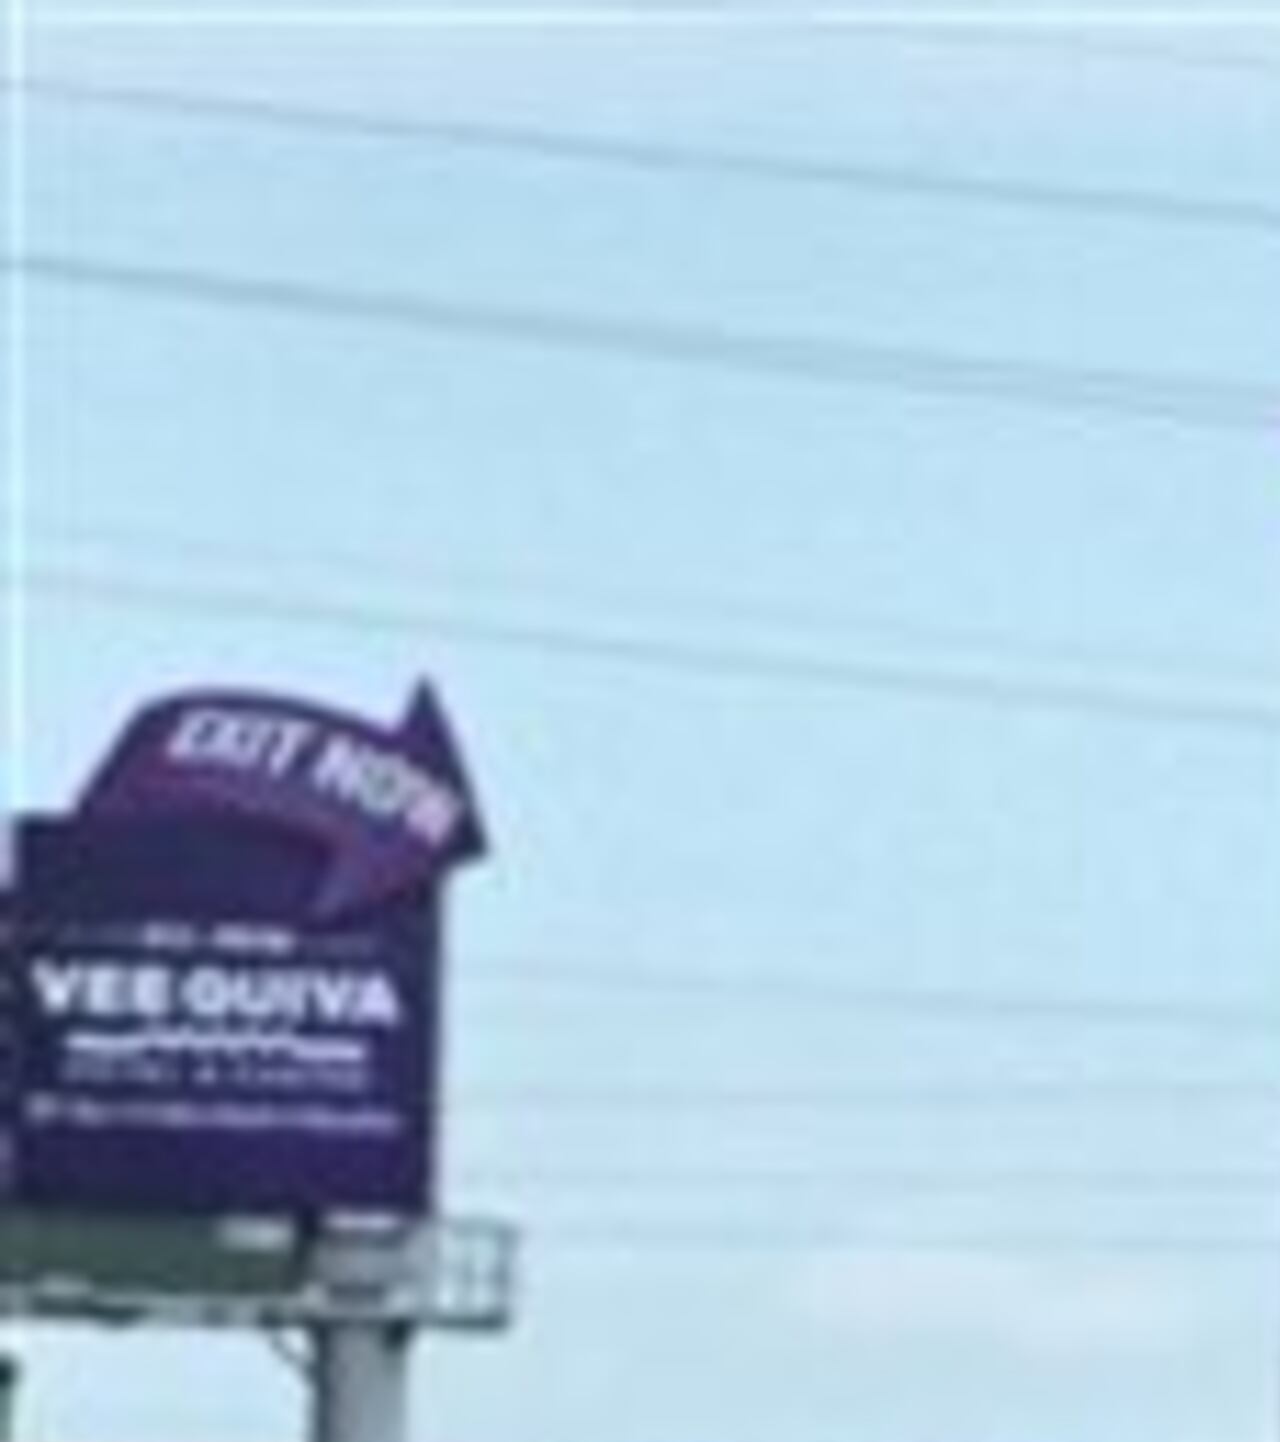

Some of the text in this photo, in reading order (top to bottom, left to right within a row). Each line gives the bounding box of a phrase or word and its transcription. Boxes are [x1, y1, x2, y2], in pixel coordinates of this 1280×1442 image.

[165, 706, 460, 848] EXIT NOW
[31, 957, 170, 1017] VEE
